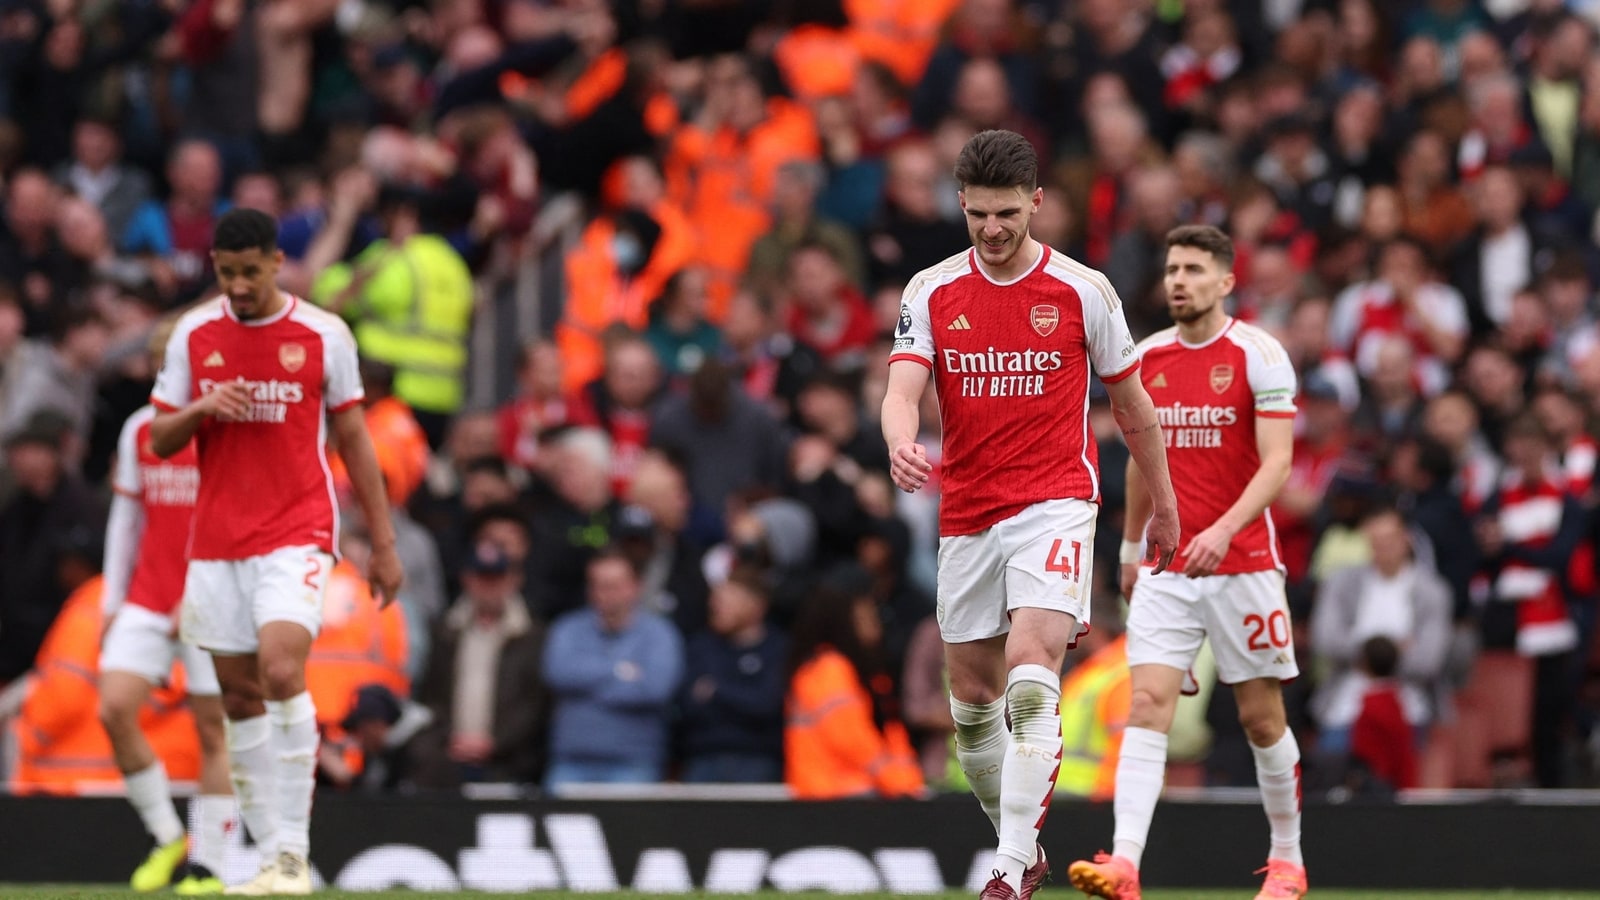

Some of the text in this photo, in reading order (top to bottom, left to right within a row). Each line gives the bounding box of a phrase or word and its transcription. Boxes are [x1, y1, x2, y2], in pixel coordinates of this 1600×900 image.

[943, 346, 1062, 373] Emirates
[962, 374, 1044, 397] FLY BETTER
[1154, 401, 1237, 426] mirates
[1176, 428, 1222, 448] BETTER
[302, 557, 321, 590] 2
[1045, 538, 1081, 584] 41
[1243, 609, 1290, 651] 20
[1016, 744, 1054, 763] AFC
